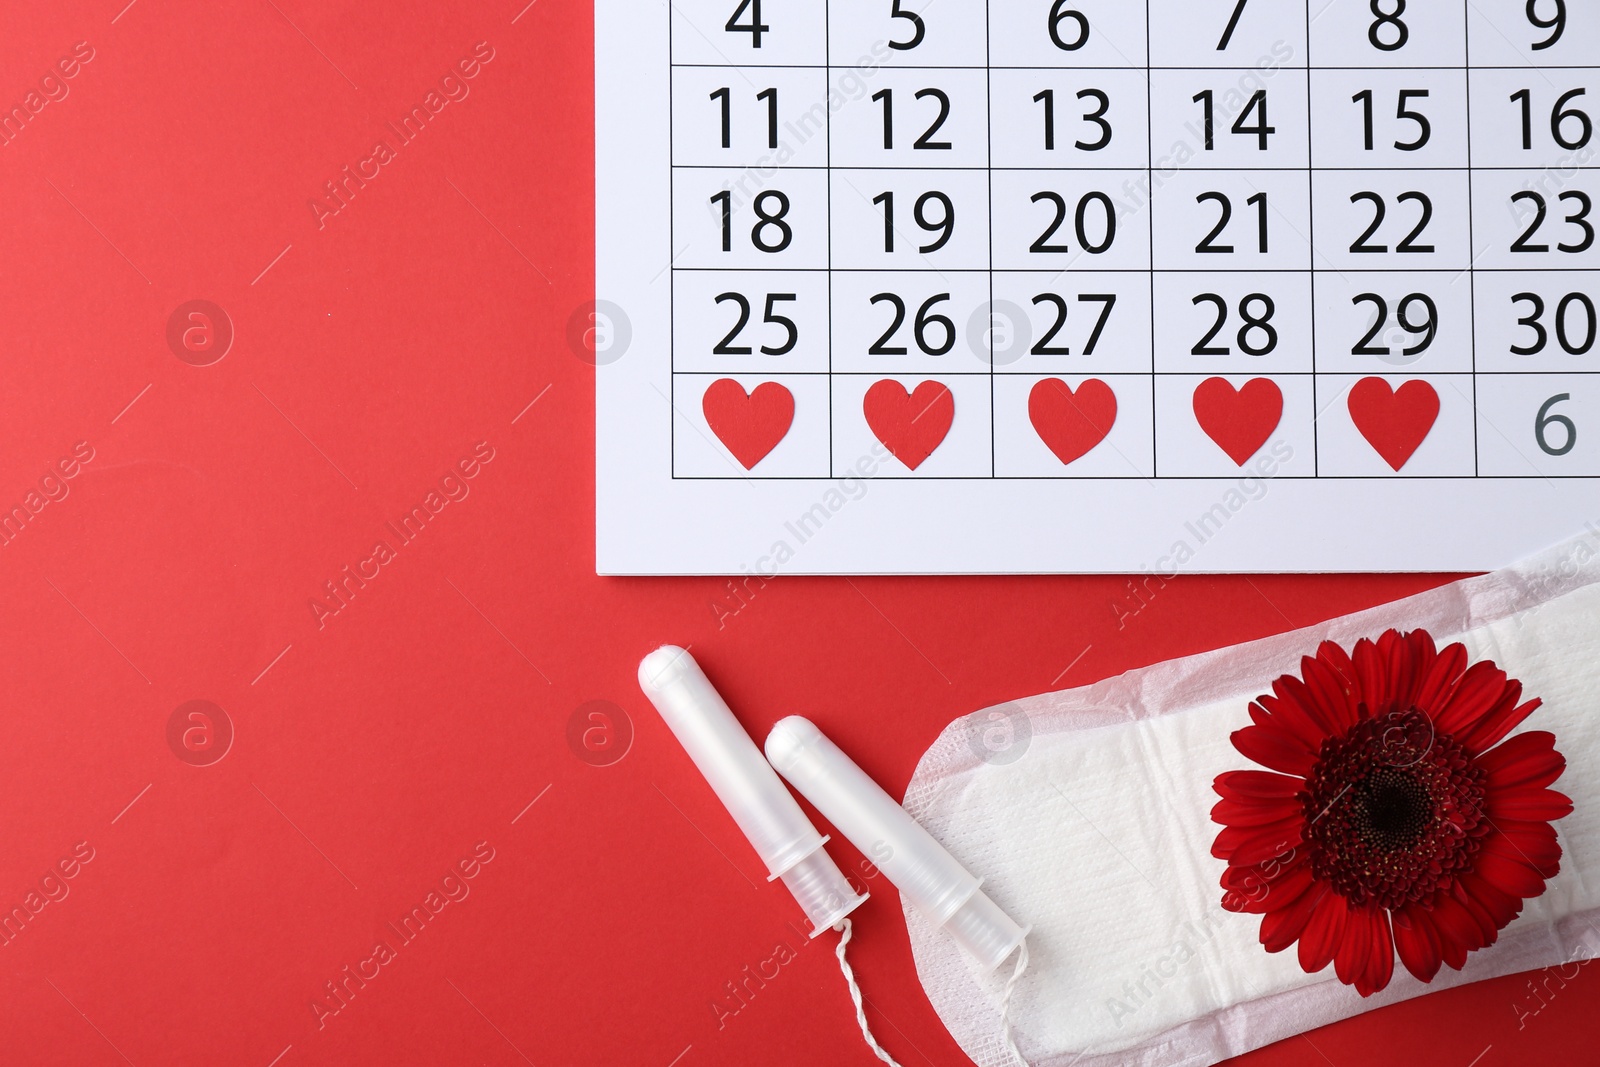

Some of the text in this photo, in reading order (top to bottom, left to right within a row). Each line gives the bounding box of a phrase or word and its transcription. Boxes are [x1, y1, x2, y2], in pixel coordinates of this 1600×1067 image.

[725, 0, 1566, 51] 4 5 6 7 8 9
[710, 88, 1592, 151] 11 12 13 14 15 16
[710, 190, 1594, 254] 18 19 20 21 22 23
[713, 292, 1596, 356] 25 26 27 28 29 30
[1535, 393, 1576, 456] 6
